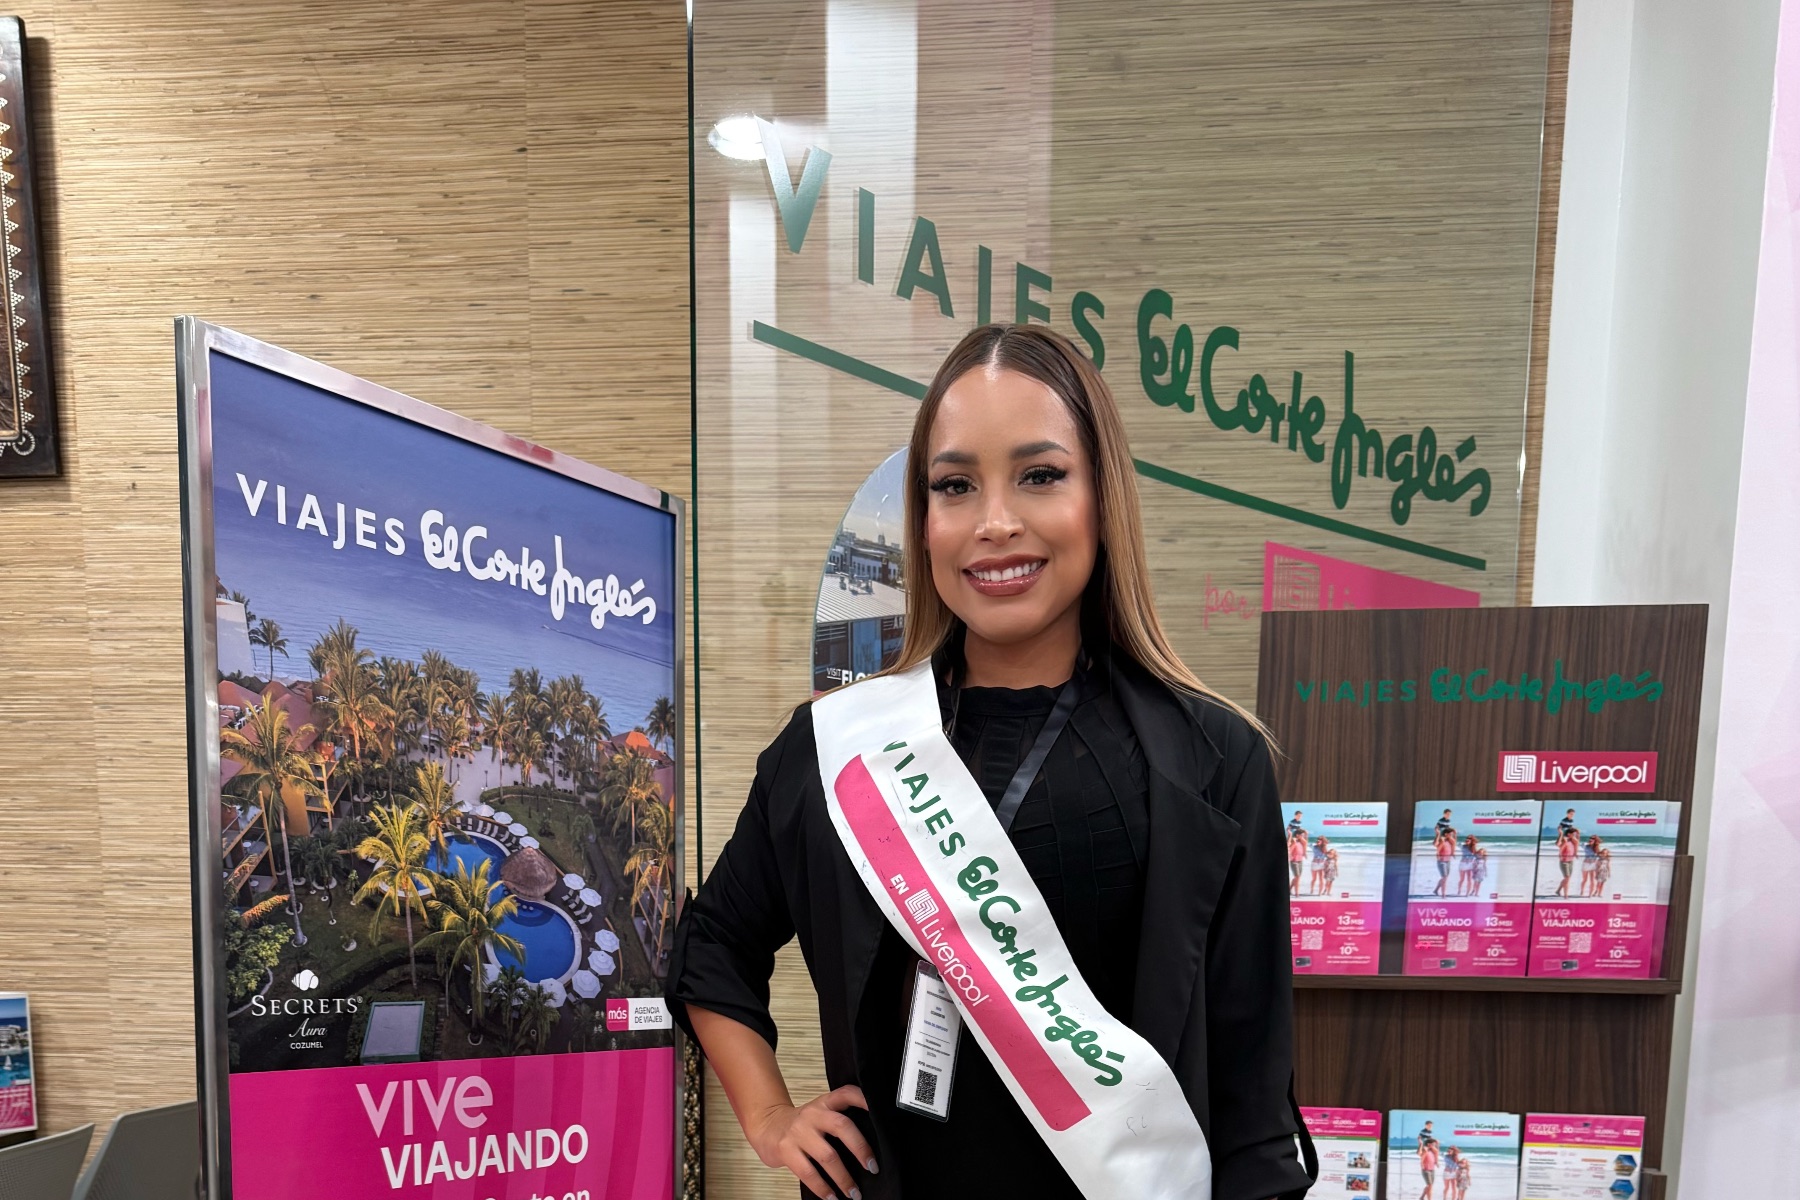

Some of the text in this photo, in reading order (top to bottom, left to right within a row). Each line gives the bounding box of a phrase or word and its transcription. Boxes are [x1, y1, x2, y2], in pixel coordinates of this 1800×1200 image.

[1201, 325, 1325, 465] Corte
[1332, 350, 1492, 526] Inglés
[236, 473, 405, 555] VIAJES
[462, 525, 548, 595] Corte
[550, 535, 656, 629] Inglés
[826, 668, 841, 676] VISIT
[1295, 680, 1417, 707] VIAJES
[1464, 668, 1543, 702] Corte
[1545, 659, 1663, 715] Inglés
[1540, 760, 1648, 788] Liverpool
[1337, 916, 1350, 925] 13
[1421, 918, 1472, 927] VIAJANDO
[1485, 917, 1498, 927] 13
[1543, 919, 1595, 927] VIAJANDO
[1608, 918, 1621, 928] 13
[890, 873, 909, 895] EN
[921, 919, 990, 1006] Liverpool
[979, 895, 1038, 982] Corte
[1015, 974, 1126, 1087] Inglés
[608, 1007, 627, 1020] más
[288, 1018, 327, 1037] Aura
[381, 1125, 589, 1189] VIAJANDO
